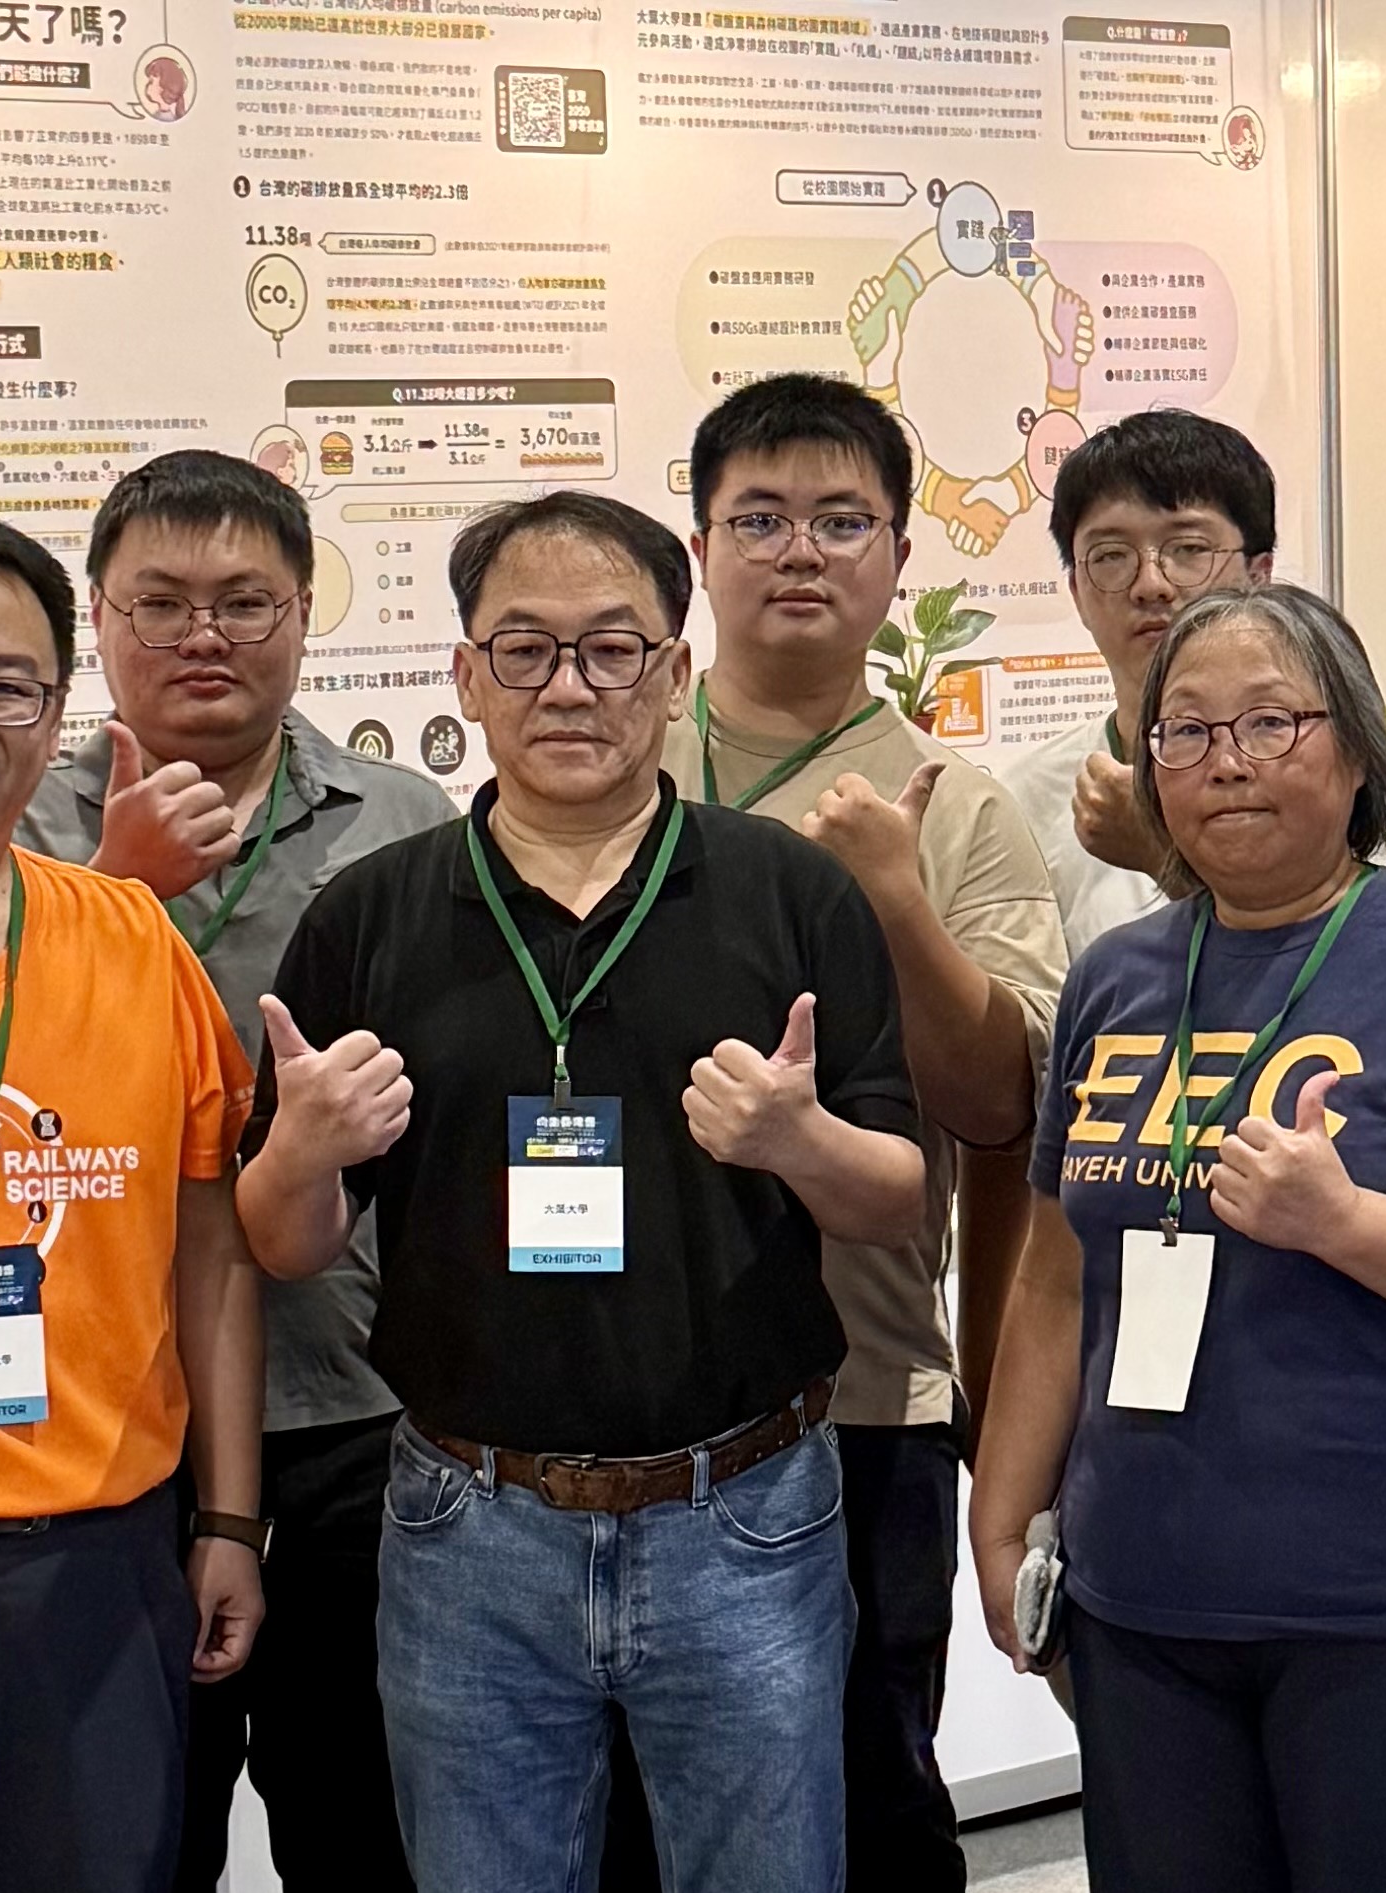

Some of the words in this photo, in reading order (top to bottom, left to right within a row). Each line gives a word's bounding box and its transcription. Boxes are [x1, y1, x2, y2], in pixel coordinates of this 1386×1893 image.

[956, 219, 986, 241] 實踐
[1068, 1031, 1364, 1148] EEC
[3, 1144, 139, 1176] RAILWAYS
[1062, 1154, 1128, 1184] AYEH
[5, 1173, 126, 1204] SCIENCE
[544, 1203, 589, 1215] 大葉大學
[532, 1253, 602, 1265] EXHIBITOR
